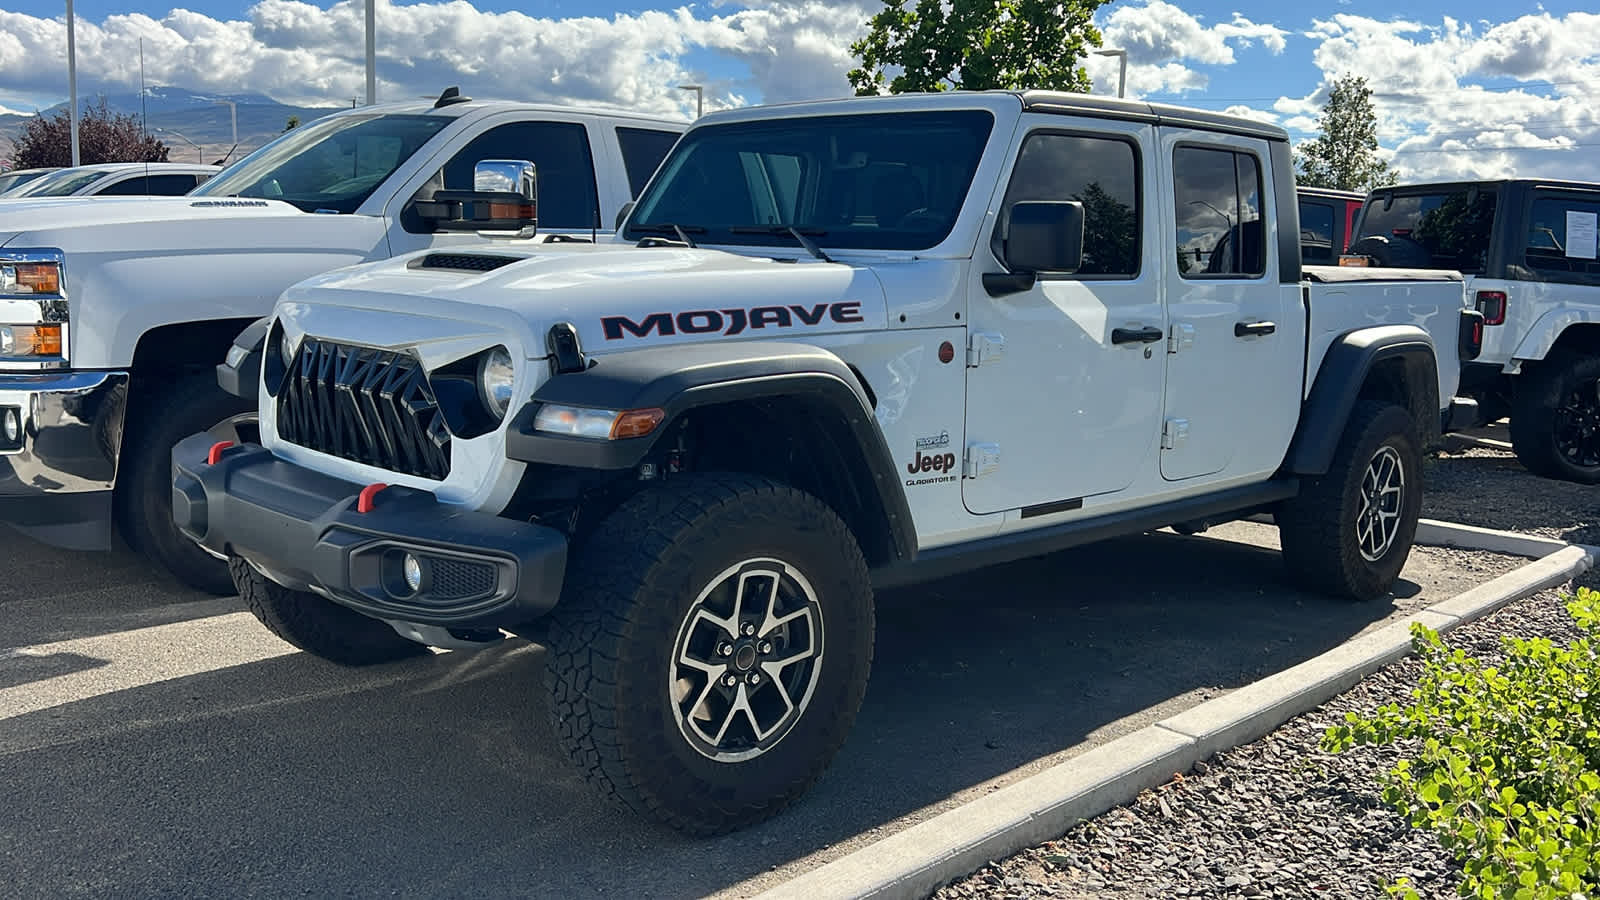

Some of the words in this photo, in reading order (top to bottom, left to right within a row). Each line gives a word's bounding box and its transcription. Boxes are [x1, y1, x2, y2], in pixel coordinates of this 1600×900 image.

[600, 301, 864, 340] MOJAVE
[907, 452, 955, 474] Jeep
[906, 476, 949, 486] GLADIATOR
